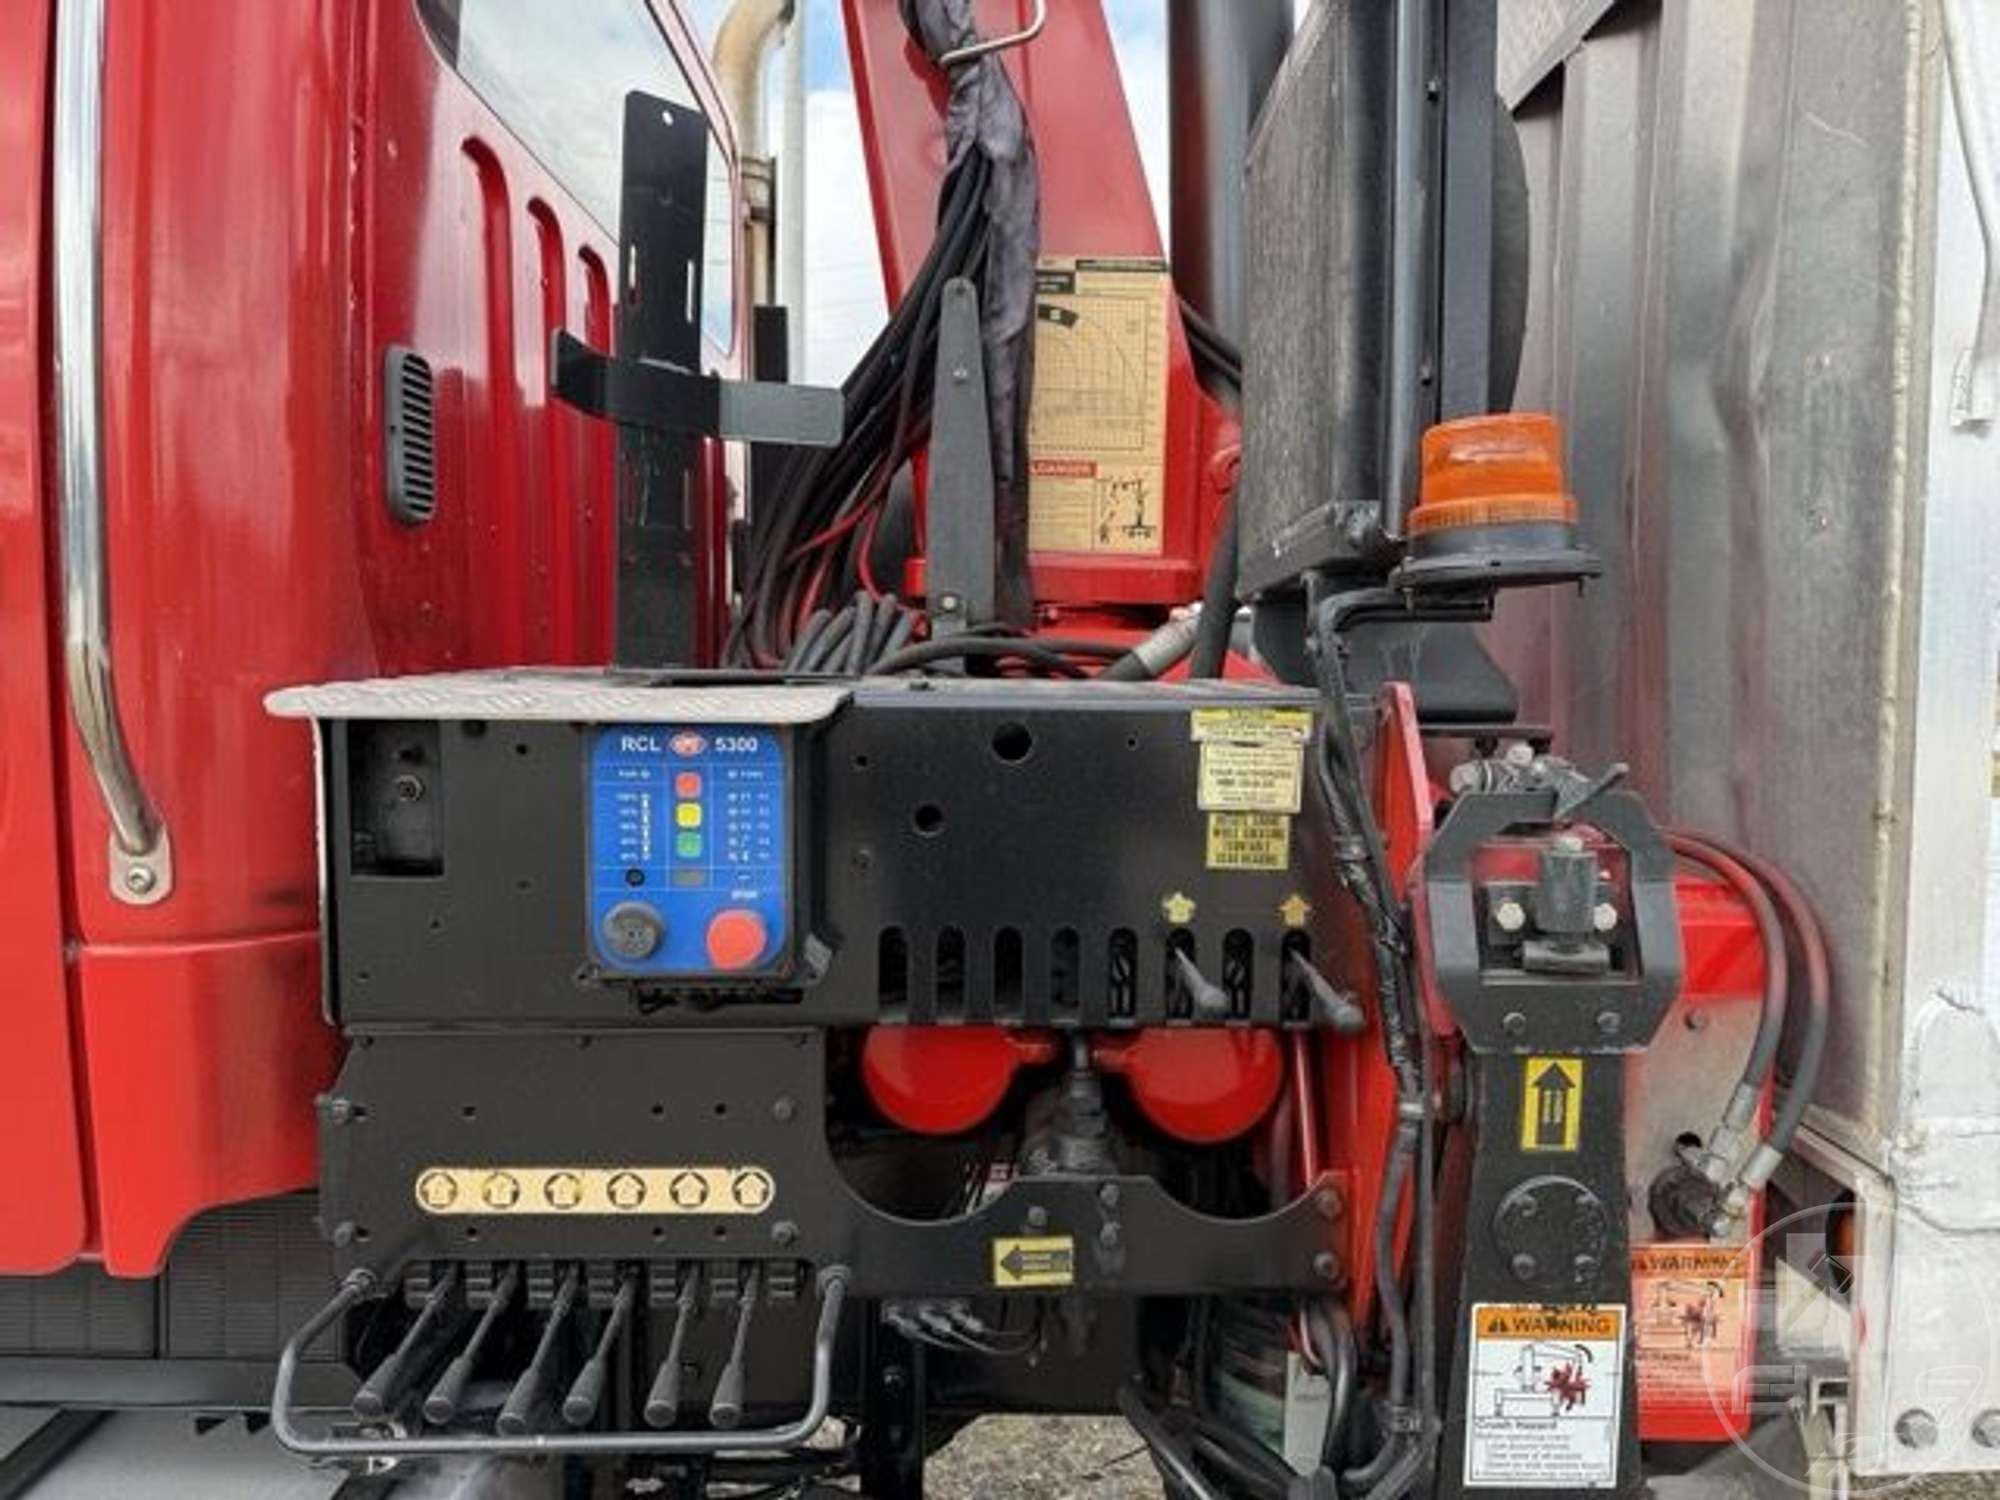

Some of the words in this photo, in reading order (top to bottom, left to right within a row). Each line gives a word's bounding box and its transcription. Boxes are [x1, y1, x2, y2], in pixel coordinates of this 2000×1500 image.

[621, 736, 661, 751] RCL
[715, 737, 758, 751] 5300
[1513, 1317, 1611, 1333] WARNING
